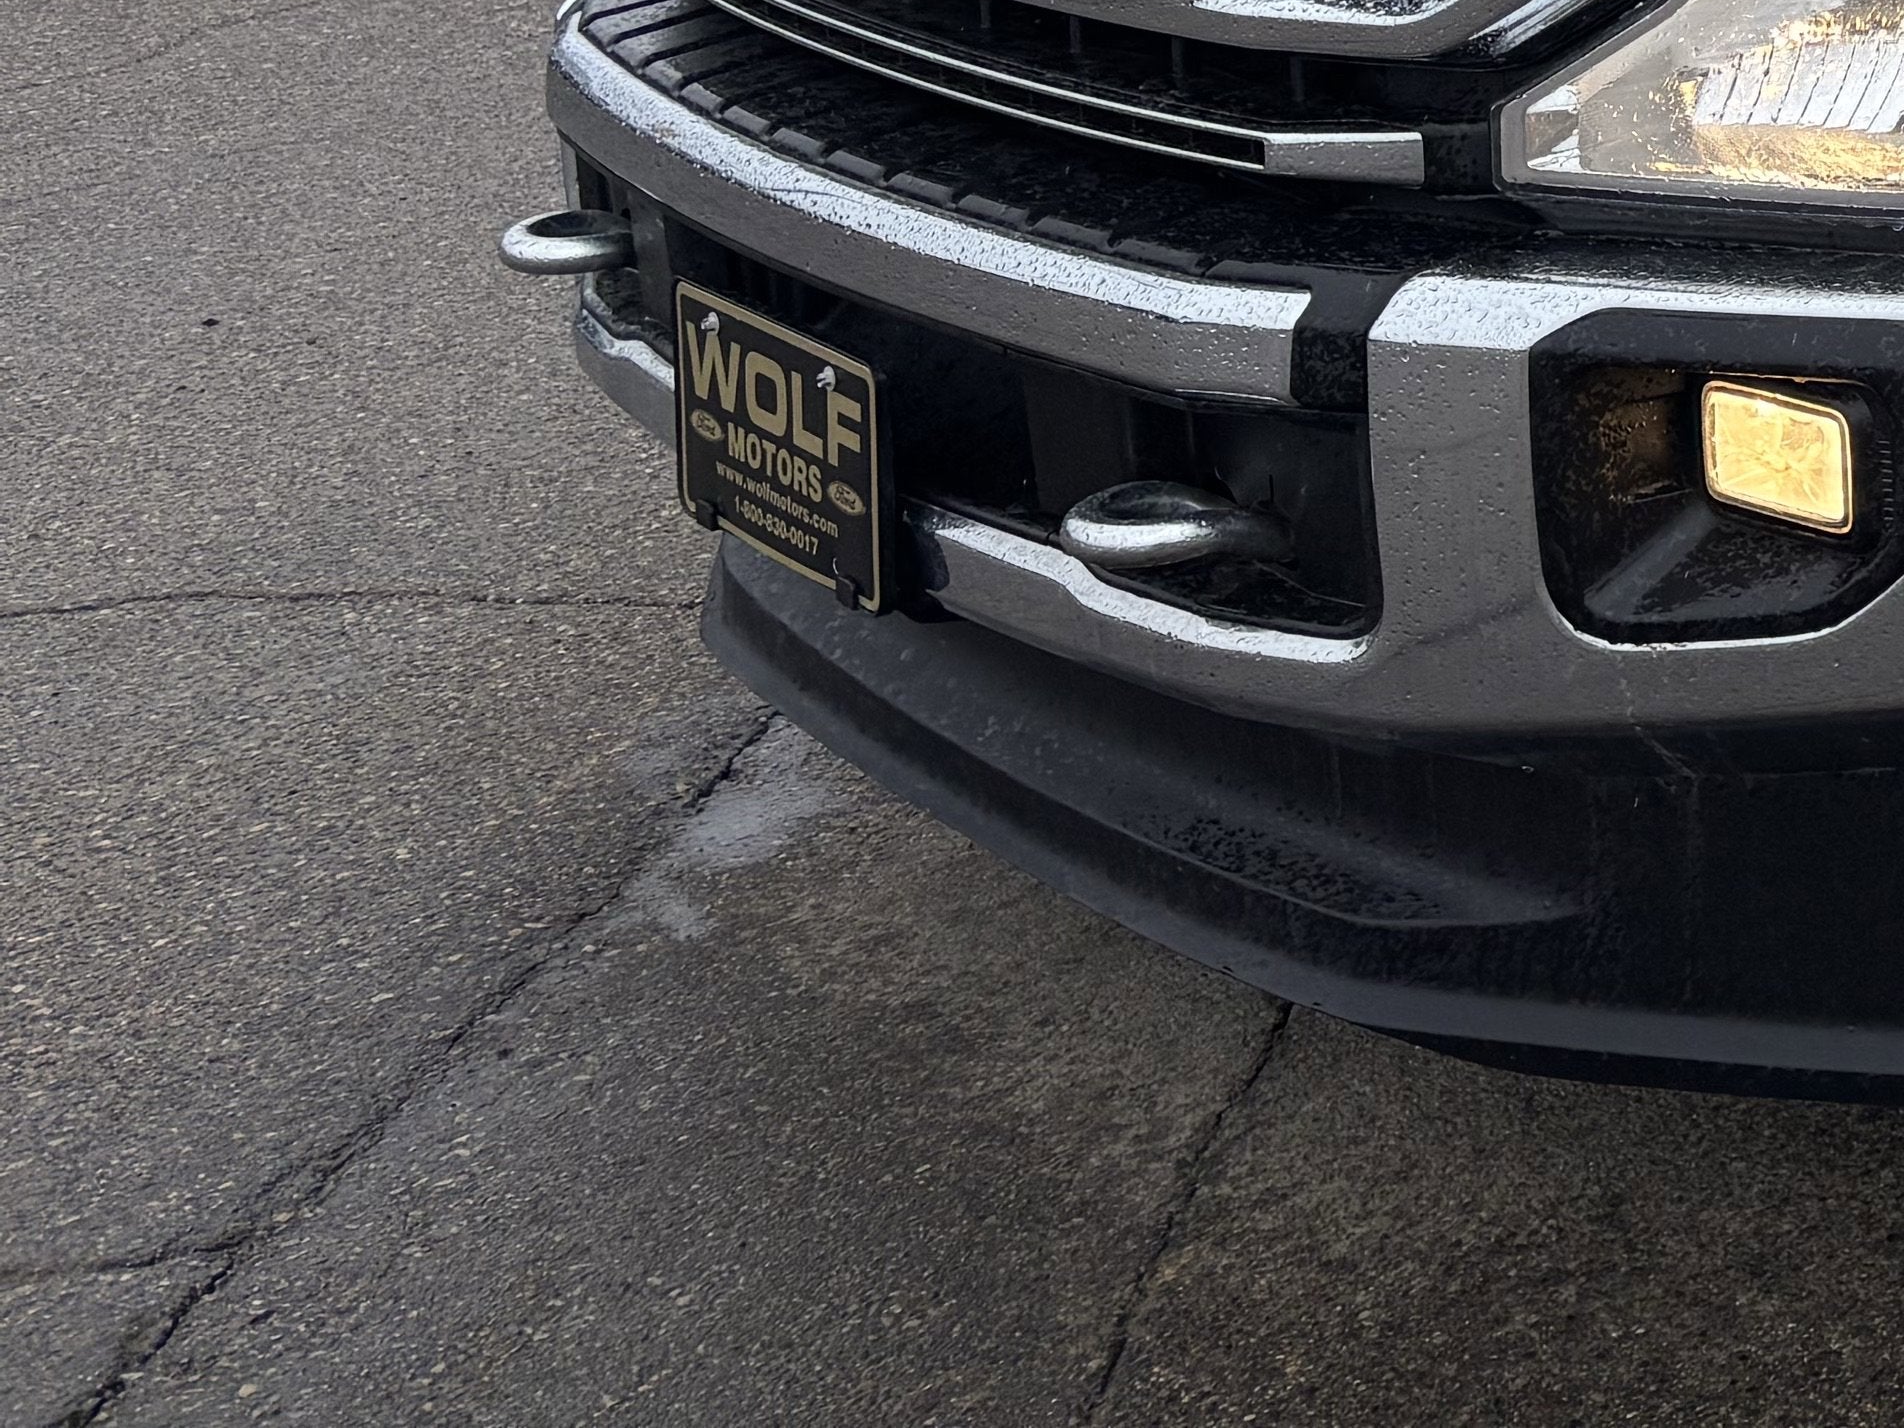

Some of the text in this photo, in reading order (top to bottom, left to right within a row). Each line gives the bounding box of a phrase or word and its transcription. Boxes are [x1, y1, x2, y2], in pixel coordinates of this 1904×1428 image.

[686, 321, 862, 467] WOLF
[715, 460, 839, 538] www.wolfmotors.com
[727, 421, 823, 503] MOTORS
[735, 495, 819, 555] 1-800-830-0017
